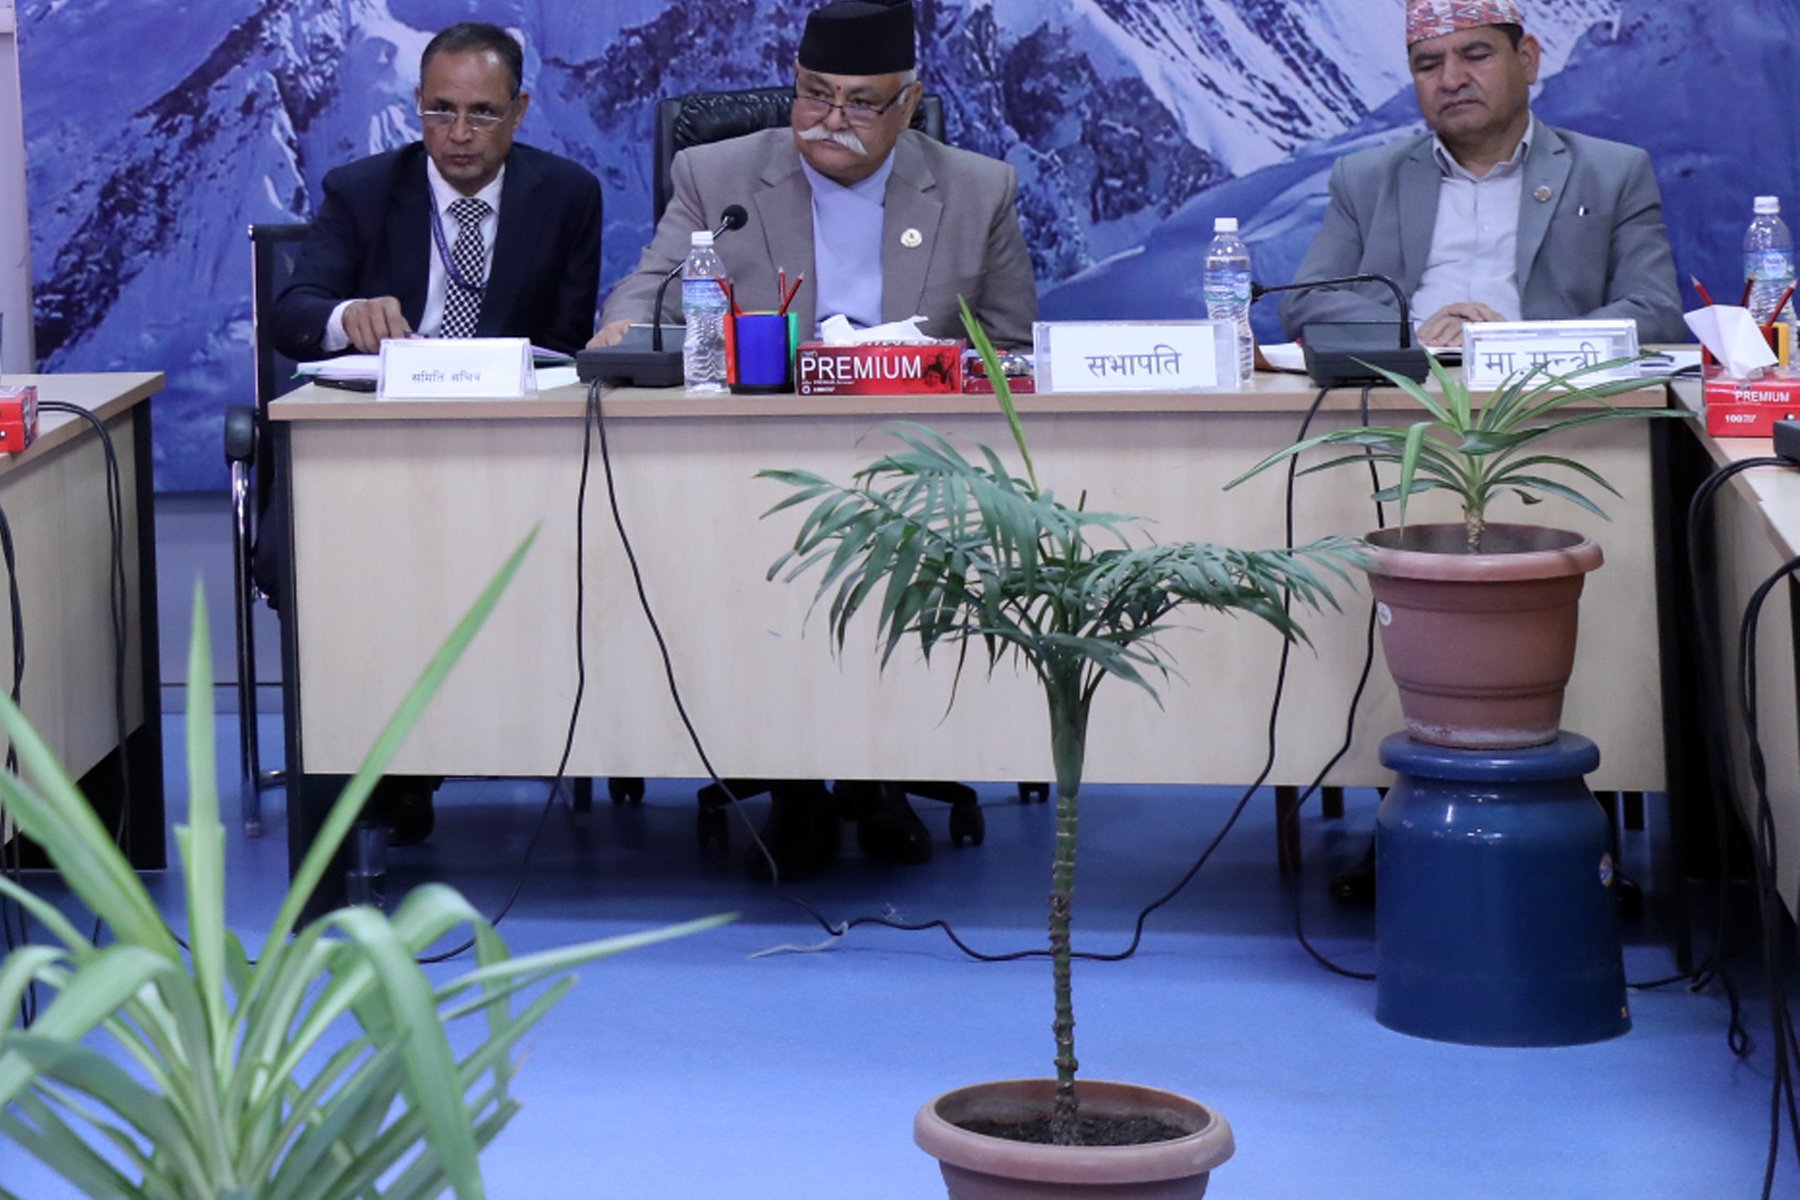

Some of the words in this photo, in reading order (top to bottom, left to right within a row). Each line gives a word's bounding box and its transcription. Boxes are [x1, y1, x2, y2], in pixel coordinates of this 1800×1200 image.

[801, 355, 922, 380] PREMIUM
[1084, 343, 1183, 378] सभापति
[1735, 391, 1791, 402] PREMIUM
